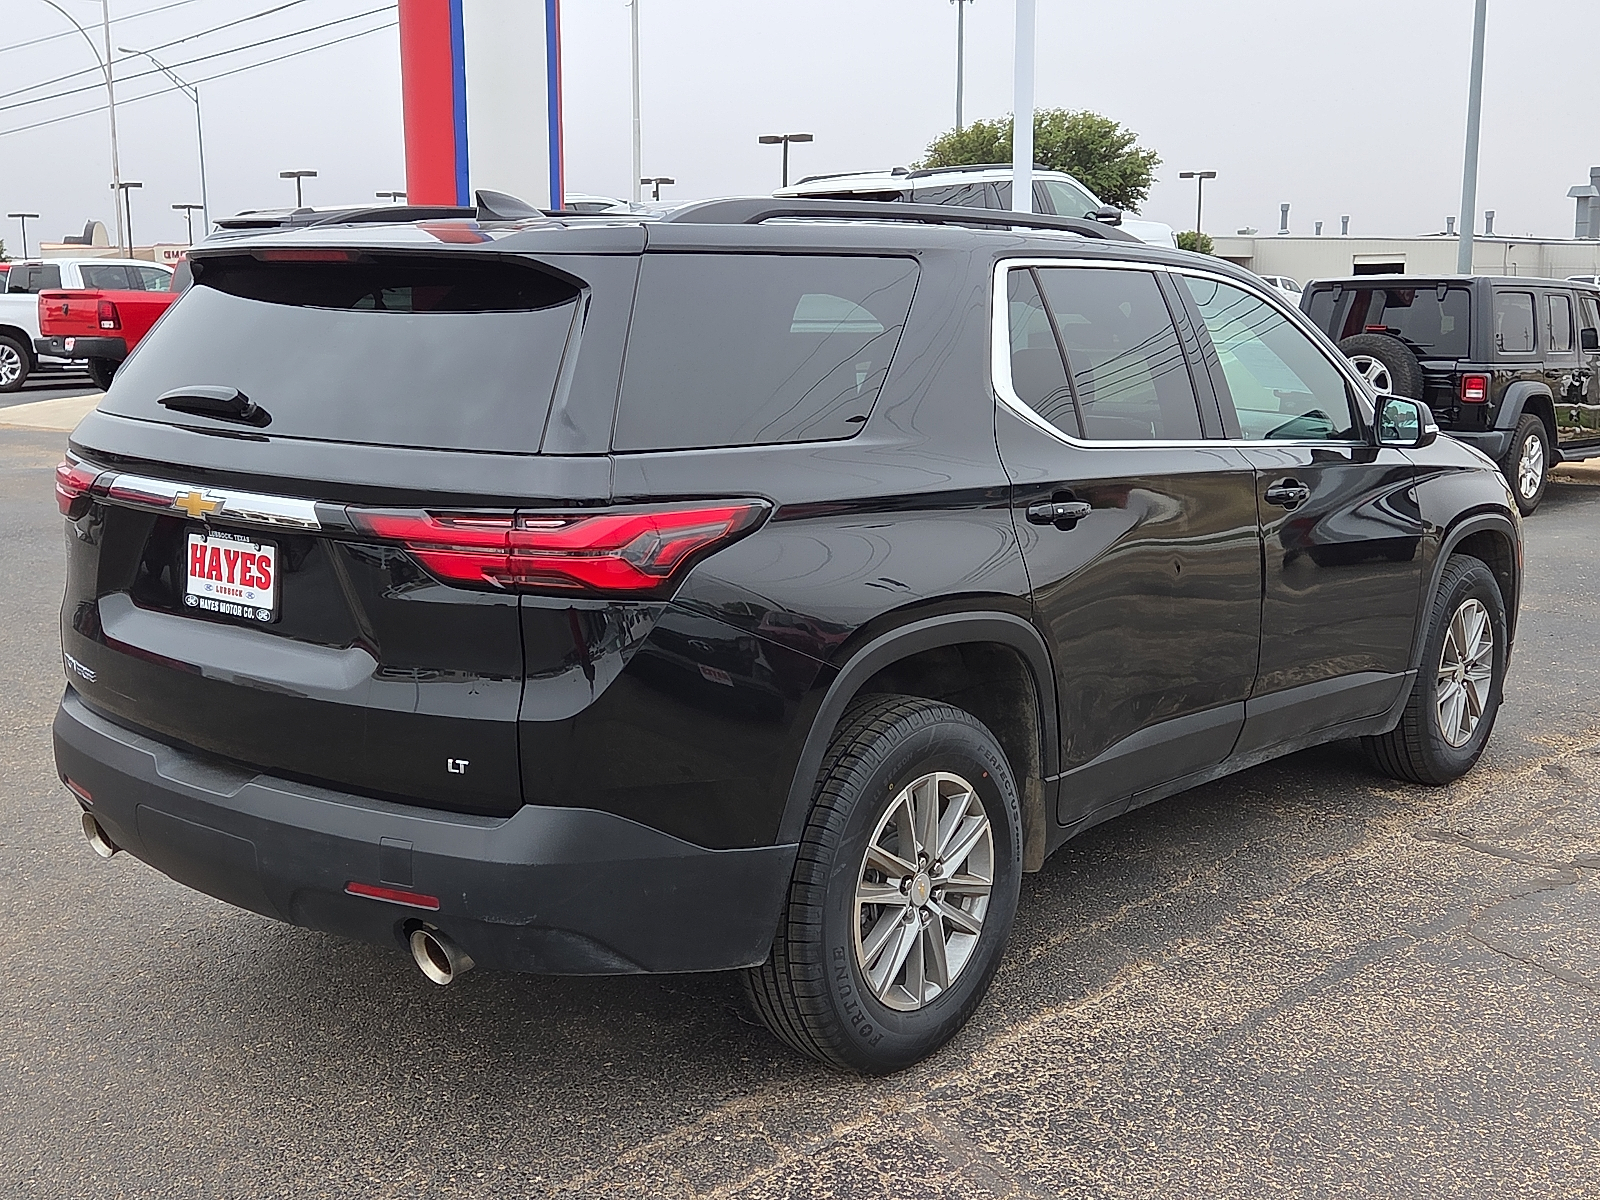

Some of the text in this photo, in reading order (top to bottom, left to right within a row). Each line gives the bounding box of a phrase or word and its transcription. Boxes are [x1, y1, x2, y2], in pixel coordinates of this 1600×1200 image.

[234, 535, 250, 543] TEXAS
[190, 543, 272, 590] HAYES
[215, 585, 243, 598] LUBBOCK
[199, 598, 219, 612] HAYES
[220, 602, 242, 617] MOTOR
[243, 607, 255, 619] CO.
[447, 758, 470, 774] LT
[977, 744, 1019, 822] PERFECTUS
[832, 945, 885, 1048] FORTUNE
